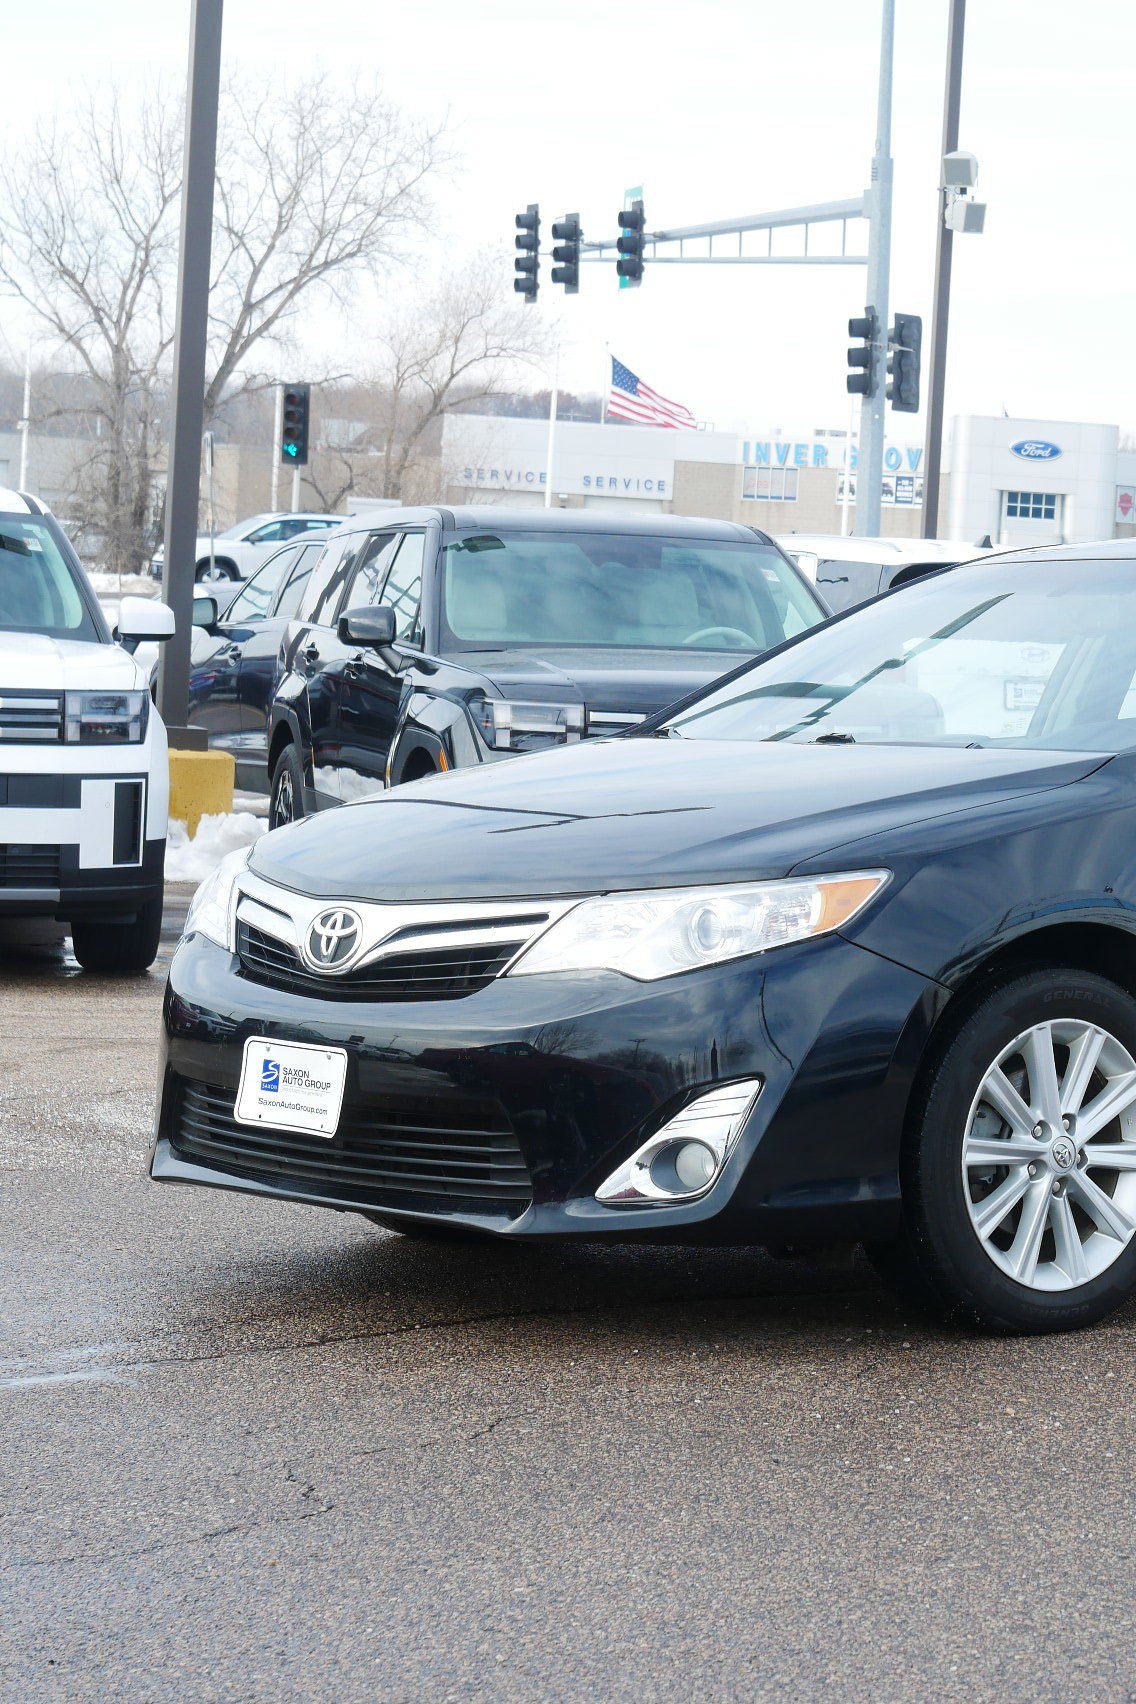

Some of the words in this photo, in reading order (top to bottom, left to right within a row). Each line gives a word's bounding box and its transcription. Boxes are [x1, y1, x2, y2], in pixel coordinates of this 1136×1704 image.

[742, 441, 828, 467] INVER
[1021, 443, 1052, 457] Ford
[463, 467, 547, 484] SERVICE
[582, 475, 666, 491] SERVICE
[282, 1067, 309, 1078] SAXON
[282, 1076, 303, 1086] AUTO
[304, 1079, 331, 1090] GROUP
[258, 1097, 328, 1115] SaxonAutoGroup.com
